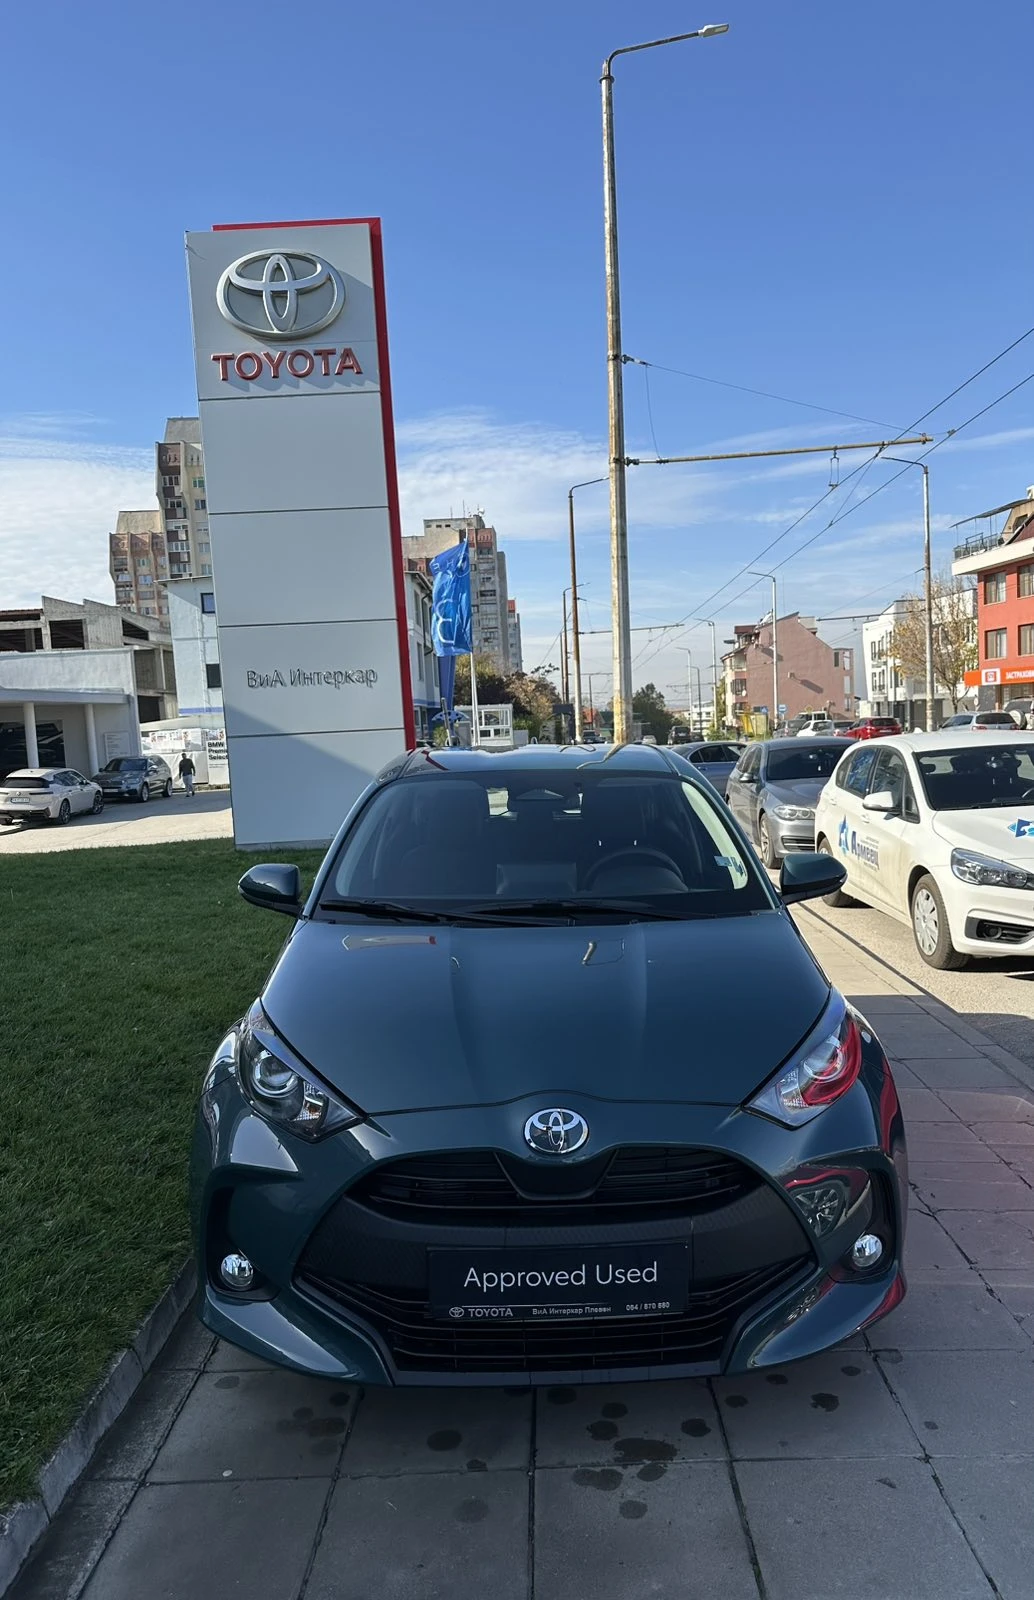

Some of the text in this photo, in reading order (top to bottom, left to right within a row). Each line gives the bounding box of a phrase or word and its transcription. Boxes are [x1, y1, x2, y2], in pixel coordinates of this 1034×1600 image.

[211, 347, 363, 381] TOYOTA
[246, 668, 378, 690] ВиА Интеркар
[463, 1261, 658, 1293] Approved Used
[467, 1307, 514, 1318] TOYOTA
[549, 1307, 583, 1316] Интеркар
